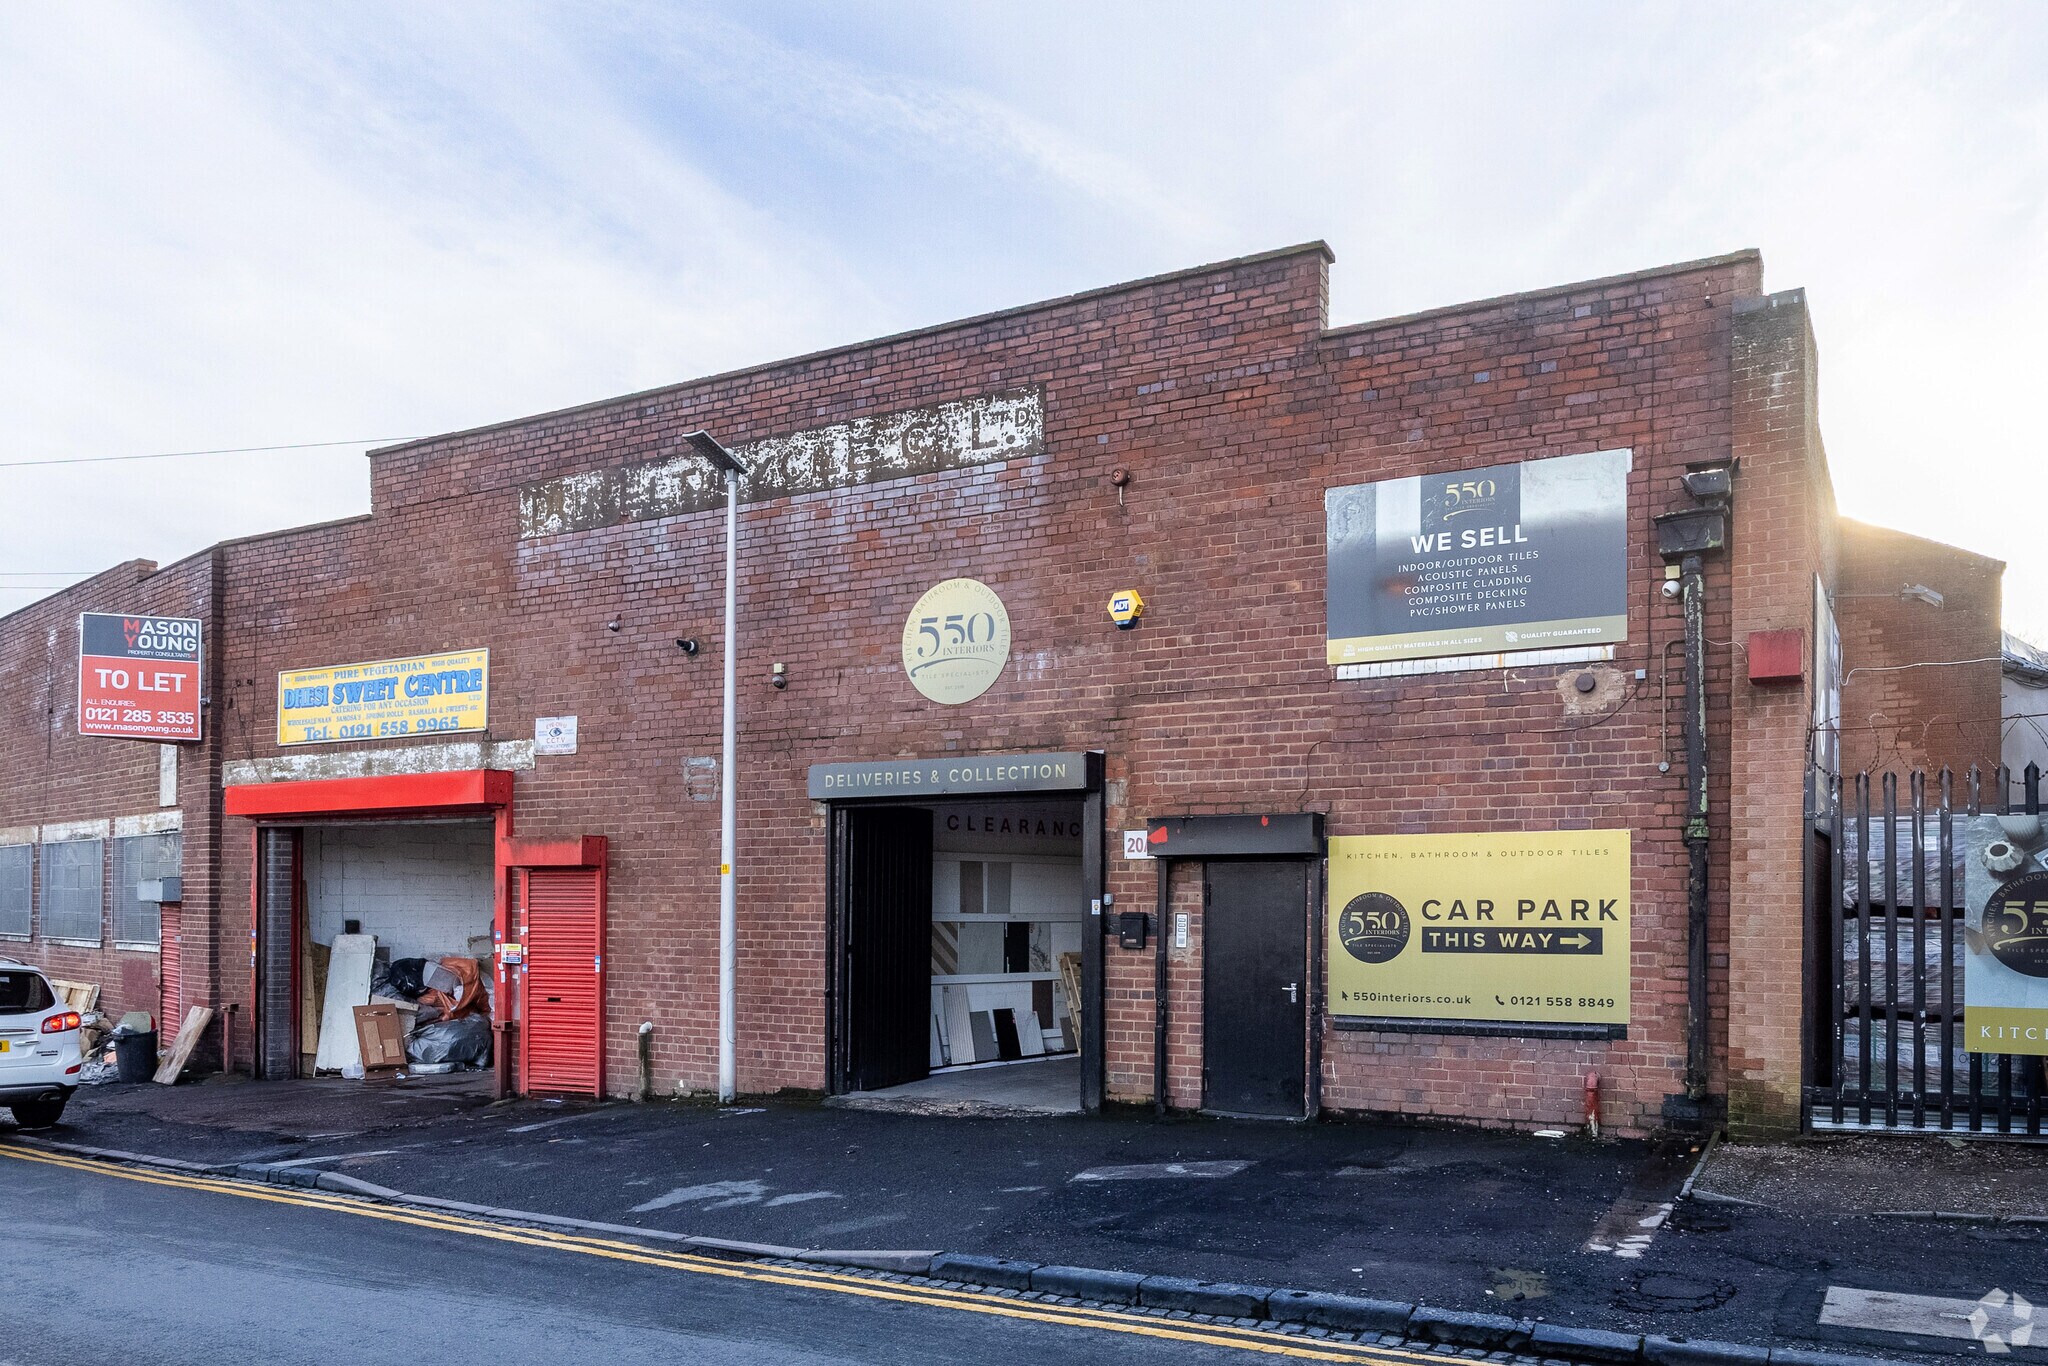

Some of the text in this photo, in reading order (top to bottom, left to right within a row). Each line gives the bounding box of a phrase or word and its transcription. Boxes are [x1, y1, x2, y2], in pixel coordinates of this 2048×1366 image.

[1445, 480, 1496, 506] 550
[1411, 524, 1528, 554] WE SELL
[1398, 550, 1539, 572] INDOOR/OUTDOOR TILES
[1418, 564, 1518, 582] ACOUSTIC PANELS
[1404, 575, 1532, 594] COMPOSITE CLADDING
[916, 582, 960, 614] BATHROOM
[974, 585, 1005, 623] OUTDOOR
[1114, 601, 1128, 610] ADT
[1408, 587, 1527, 606] COMPOSITE DECKING
[1410, 599, 1526, 617] PVC/SHOWER PANELS
[124, 618, 197, 637] MASON
[918, 612, 994, 657] 550
[1553, 628, 1601, 636] GUARANTEED
[124, 634, 197, 651] YOUNG
[943, 644, 994, 656] INTERIORS
[1404, 641, 1440, 649] MATERIALS
[334, 669, 359, 679] PURE
[363, 662, 425, 676] VEGETARIAN
[447, 657, 470, 666] QUALITY
[95, 669, 186, 692] TO LET
[284, 668, 482, 709] DHESI SWEET CENTRE
[331, 704, 362, 714] CATERING
[364, 702, 376, 711] FOR
[378, 701, 392, 709] ANY
[395, 698, 429, 708] OCCASION
[86, 708, 194, 725] 0121 285 3535
[86, 723, 193, 734] www.masonyoung.co.uk
[304, 716, 458, 740] Tel: 0121 558 9965
[825, 764, 1066, 788] DELIVERIES & COLLECTION
[1422, 899, 1618, 921] CAR PARK
[1349, 912, 1400, 935] 550
[1429, 932, 1554, 948] THIS WAY
[1353, 992, 1614, 1008] 550interiors.co.uk 0121 558 8849
